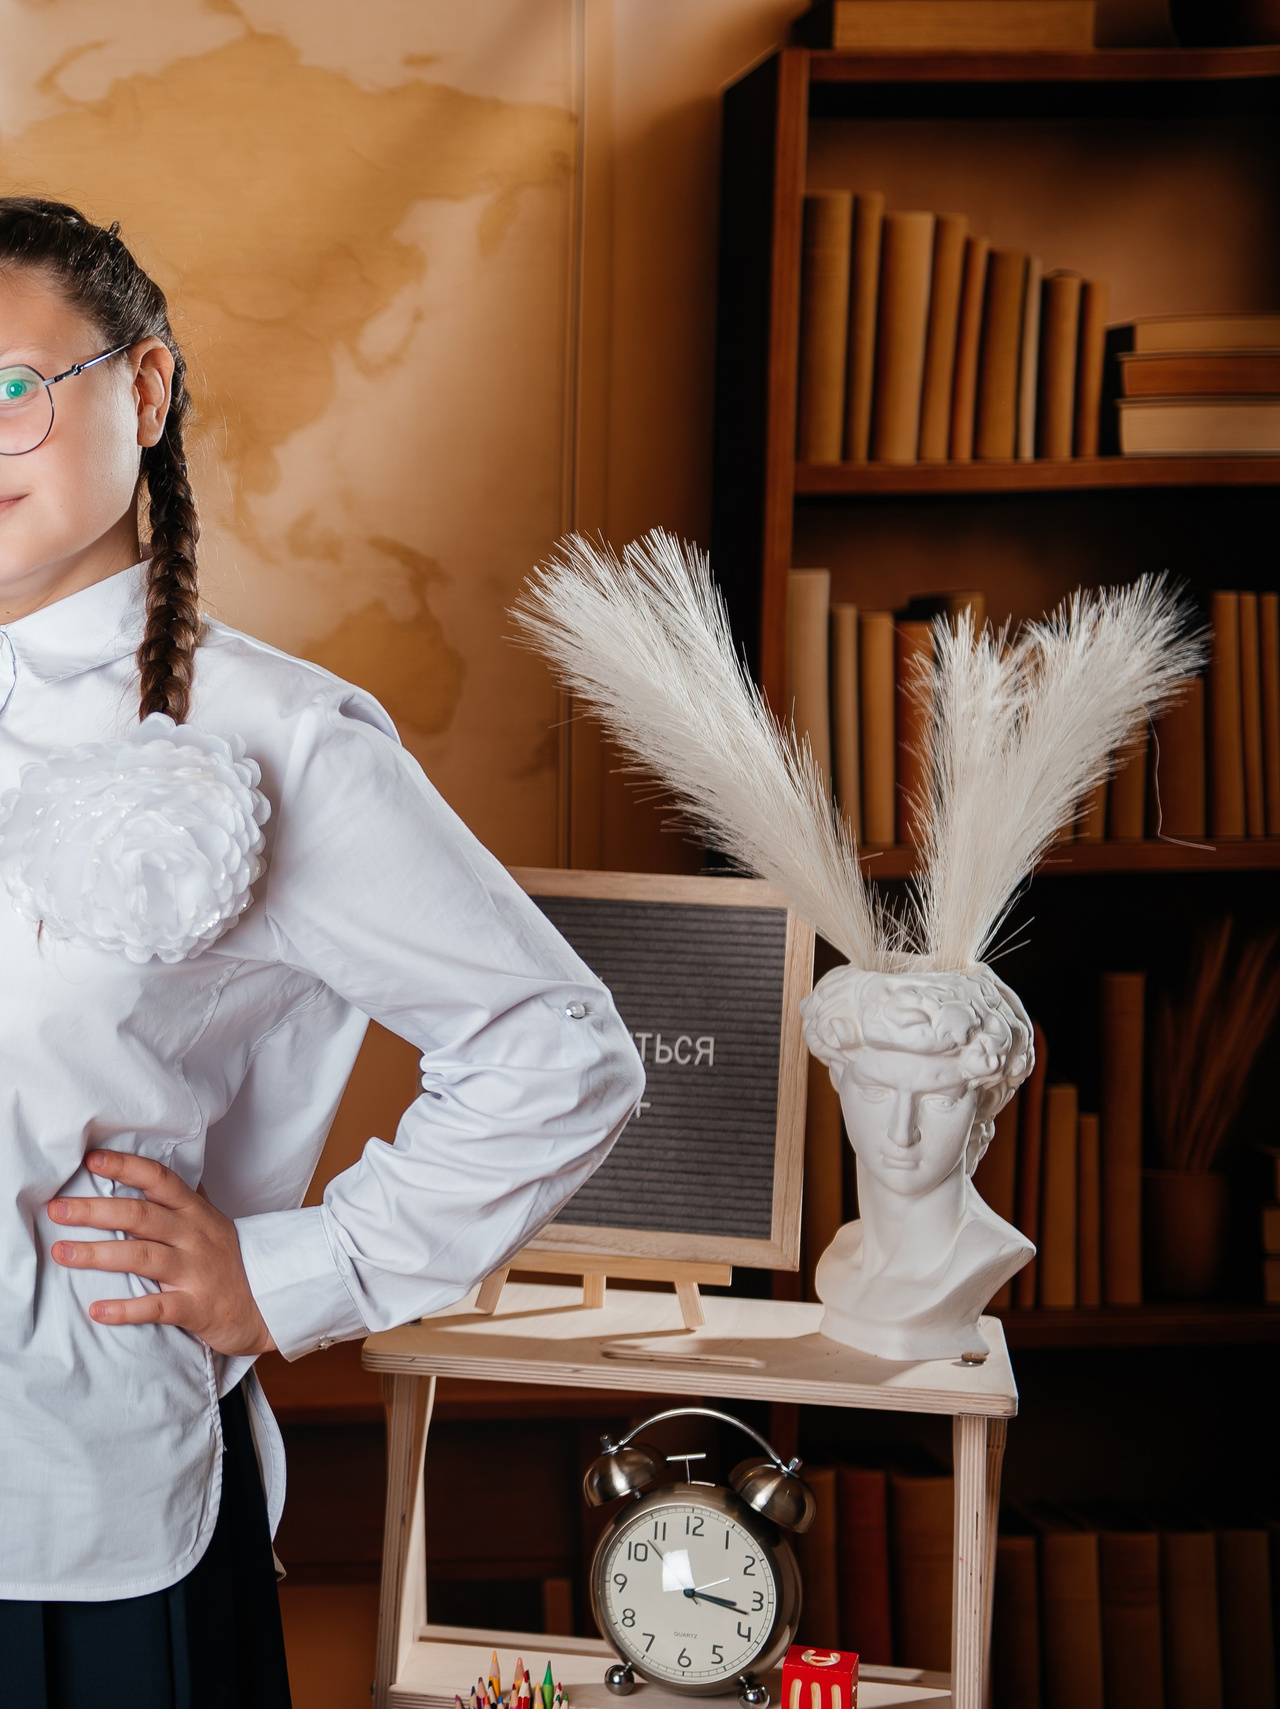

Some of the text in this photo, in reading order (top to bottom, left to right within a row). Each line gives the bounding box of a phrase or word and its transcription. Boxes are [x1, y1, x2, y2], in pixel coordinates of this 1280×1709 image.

[630, 1031, 715, 1067] ТЬСЯ
[653, 1520, 667, 1542] 11
[686, 1516, 705, 1537] 12
[724, 1530, 730, 1550] 1
[627, 1541, 648, 1562] 10
[743, 1555, 756, 1577] 2
[613, 1573, 628, 1593] 9
[751, 1591, 764, 1612] 3
[621, 1608, 636, 1628] 8
[673, 1631, 698, 1640] QUARTZ
[736, 1622, 752, 1643] 4
[642, 1633, 655, 1653] 7
[677, 1648, 692, 1668] 6
[711, 1645, 724, 1665] 5
